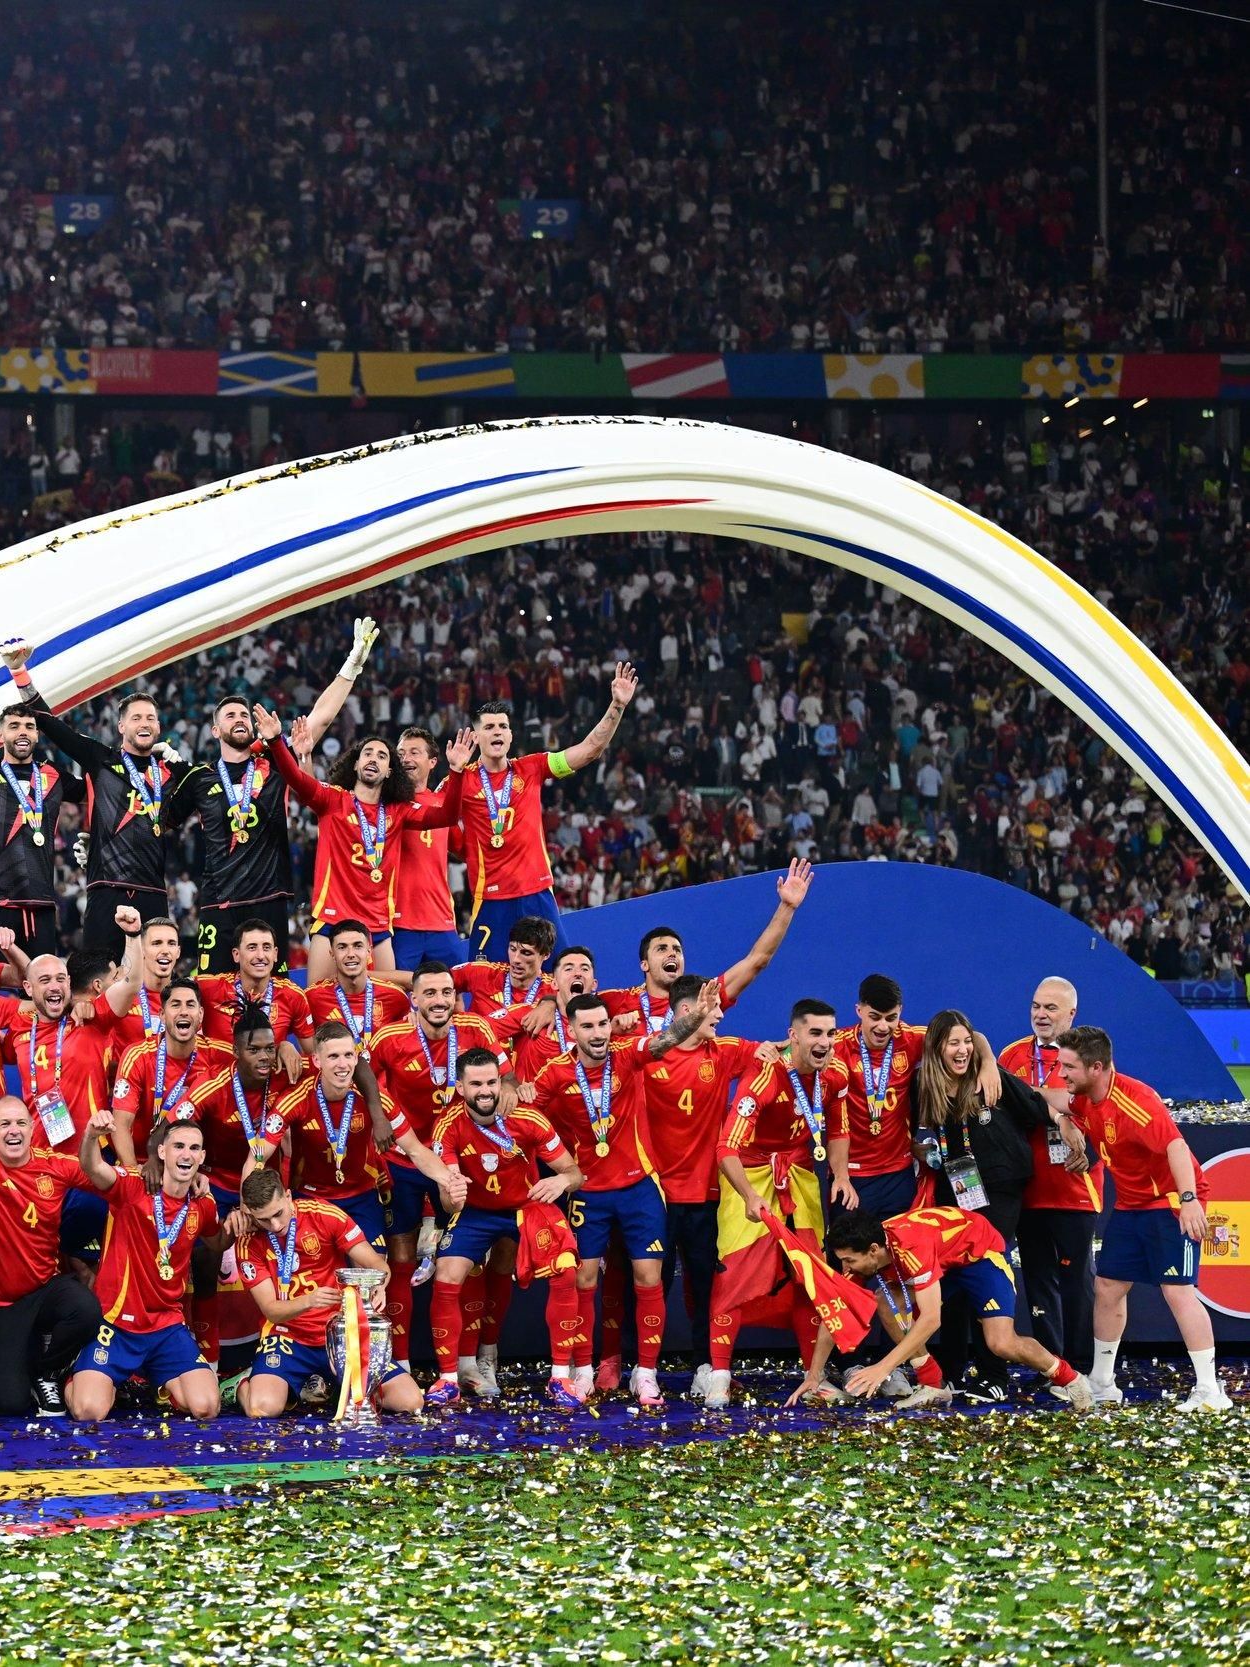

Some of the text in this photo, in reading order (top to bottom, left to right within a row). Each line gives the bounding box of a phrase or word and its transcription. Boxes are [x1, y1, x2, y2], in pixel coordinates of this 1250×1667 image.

[69, 202, 100, 220] 28
[536, 207, 568, 225] 29
[420, 829, 432, 849] 4
[351, 843, 364, 865] 2
[478, 925, 491, 950] 7
[34, 1045, 49, 1070] 4
[678, 1089, 694, 1115] 4
[1100, 1141, 1112, 1167] 4
[485, 1174, 502, 1195] 4
[22, 1202, 38, 1228] 4
[288, 1270, 319, 1301] 25
[97, 1324, 114, 1347] 8
[262, 1335, 293, 1355] 25
